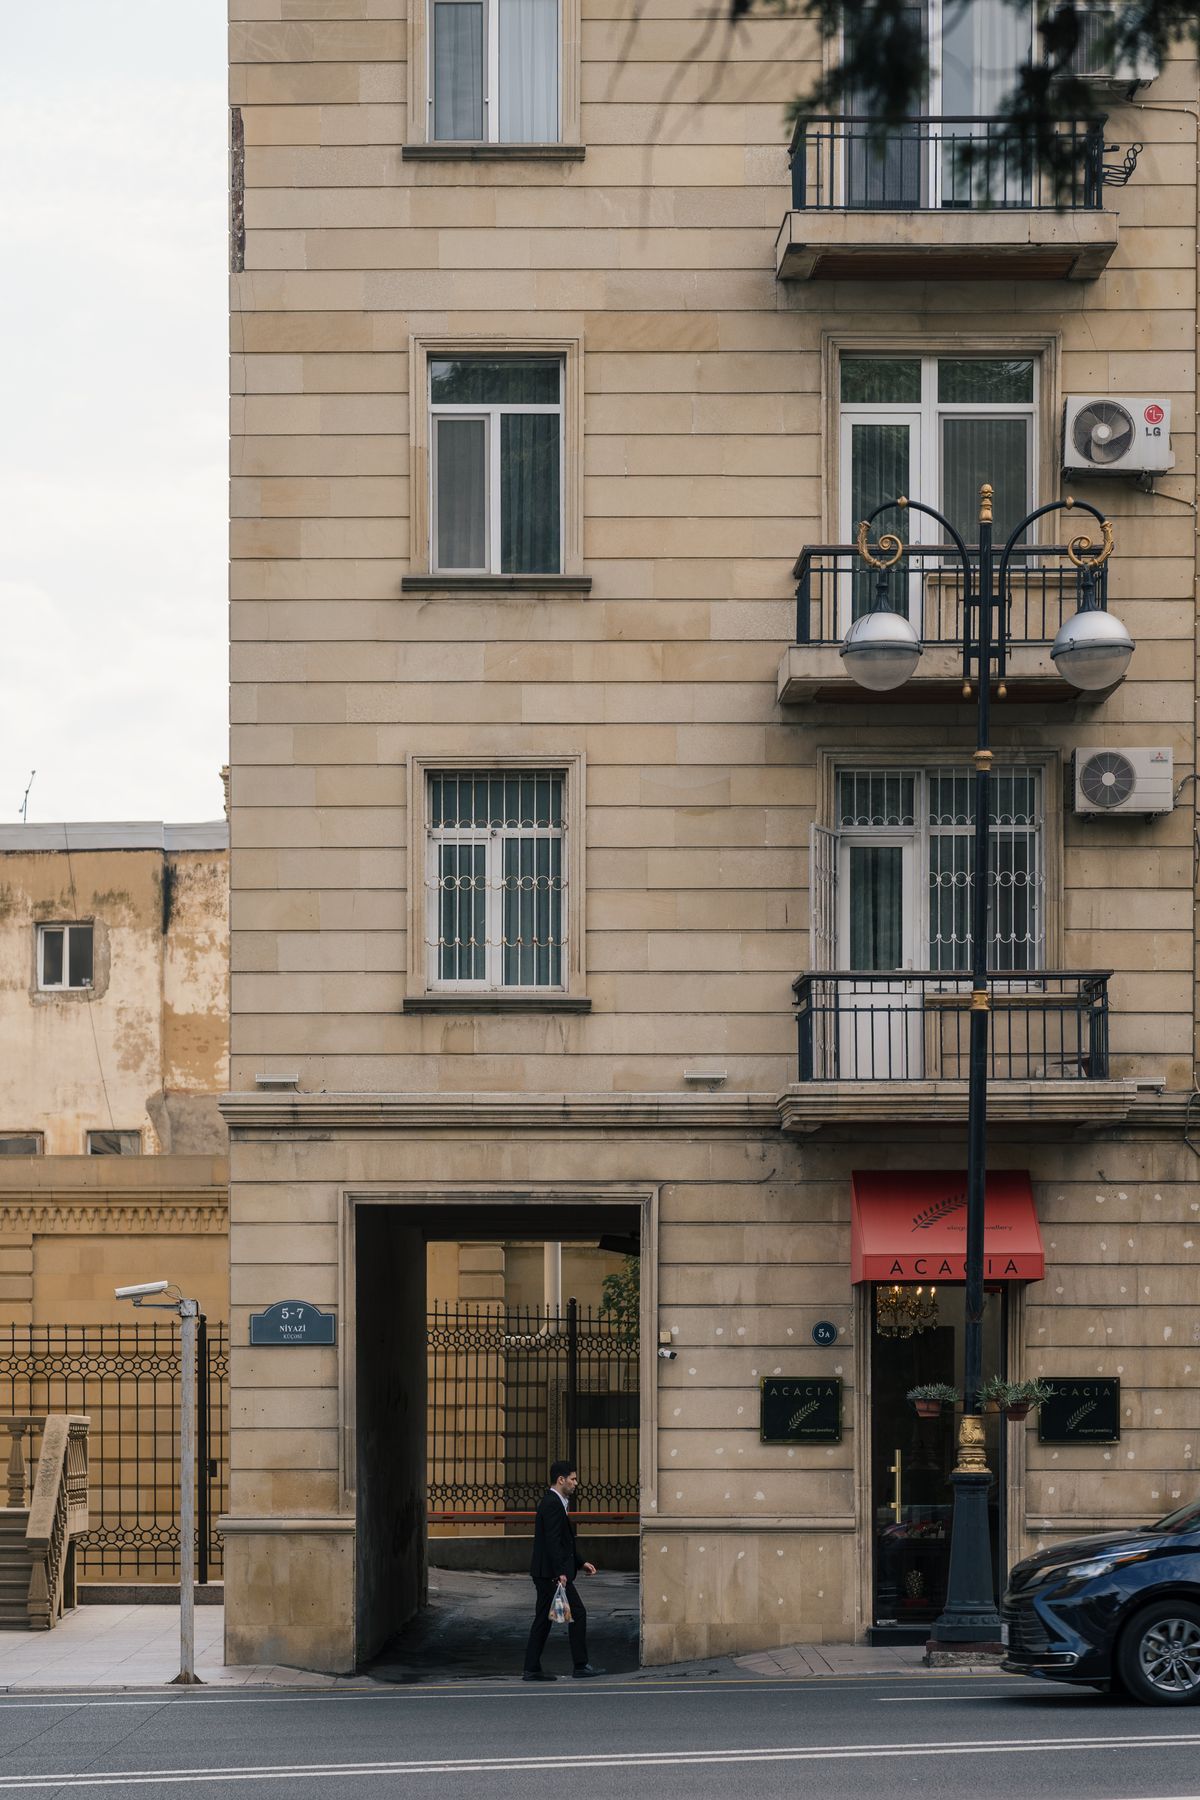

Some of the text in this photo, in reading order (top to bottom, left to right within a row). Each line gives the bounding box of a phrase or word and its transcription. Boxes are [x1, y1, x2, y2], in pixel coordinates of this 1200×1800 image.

[1145, 427, 1161, 437] LG
[890, 1259, 1018, 1275] ACAIA
[281, 1307, 304, 1319] 5-7
[279, 1324, 306, 1332] NİYAZİ
[818, 1328, 830, 1338] 5A
[770, 1387, 833, 1396] ACACIA
[1060, 1387, 1111, 1396] CACIA
